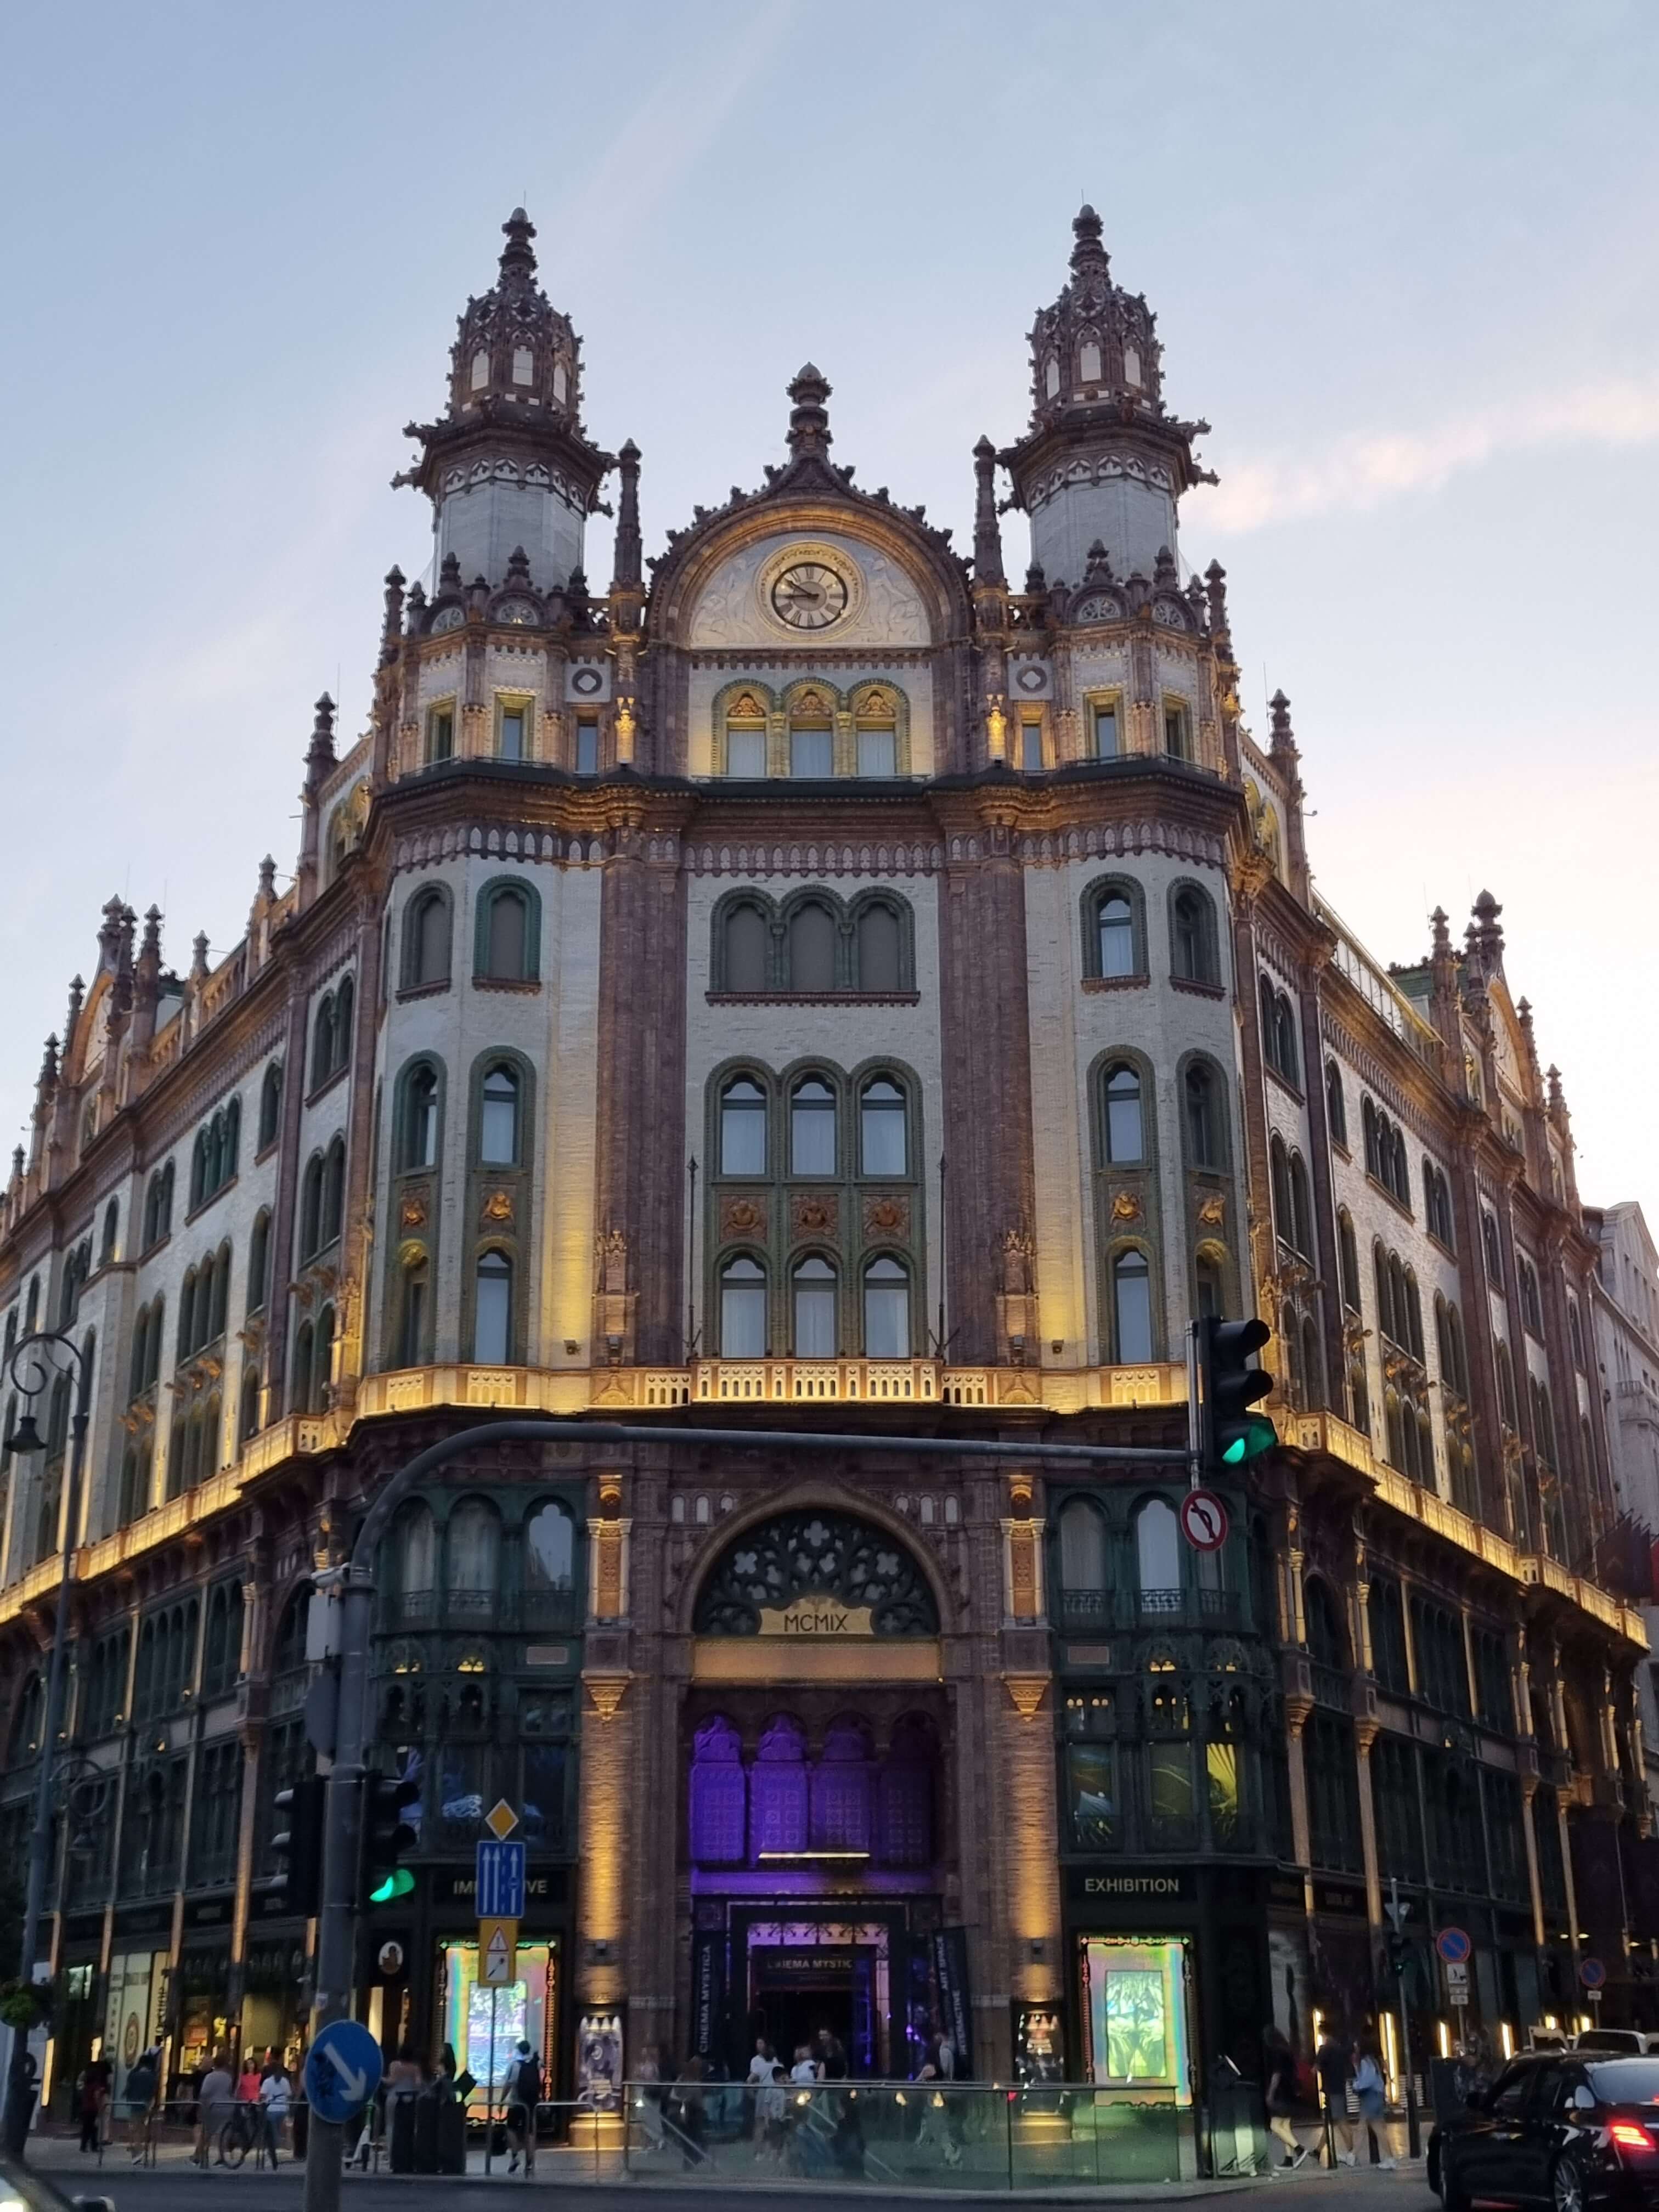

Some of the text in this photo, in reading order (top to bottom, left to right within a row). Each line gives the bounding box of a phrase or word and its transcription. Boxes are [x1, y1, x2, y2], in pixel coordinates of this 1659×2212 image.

[784, 1614, 848, 1632] MCMIX
[1085, 1878, 1180, 1892] EXHIBITION
[699, 1945, 711, 2053] CINEMA MYSTICA
